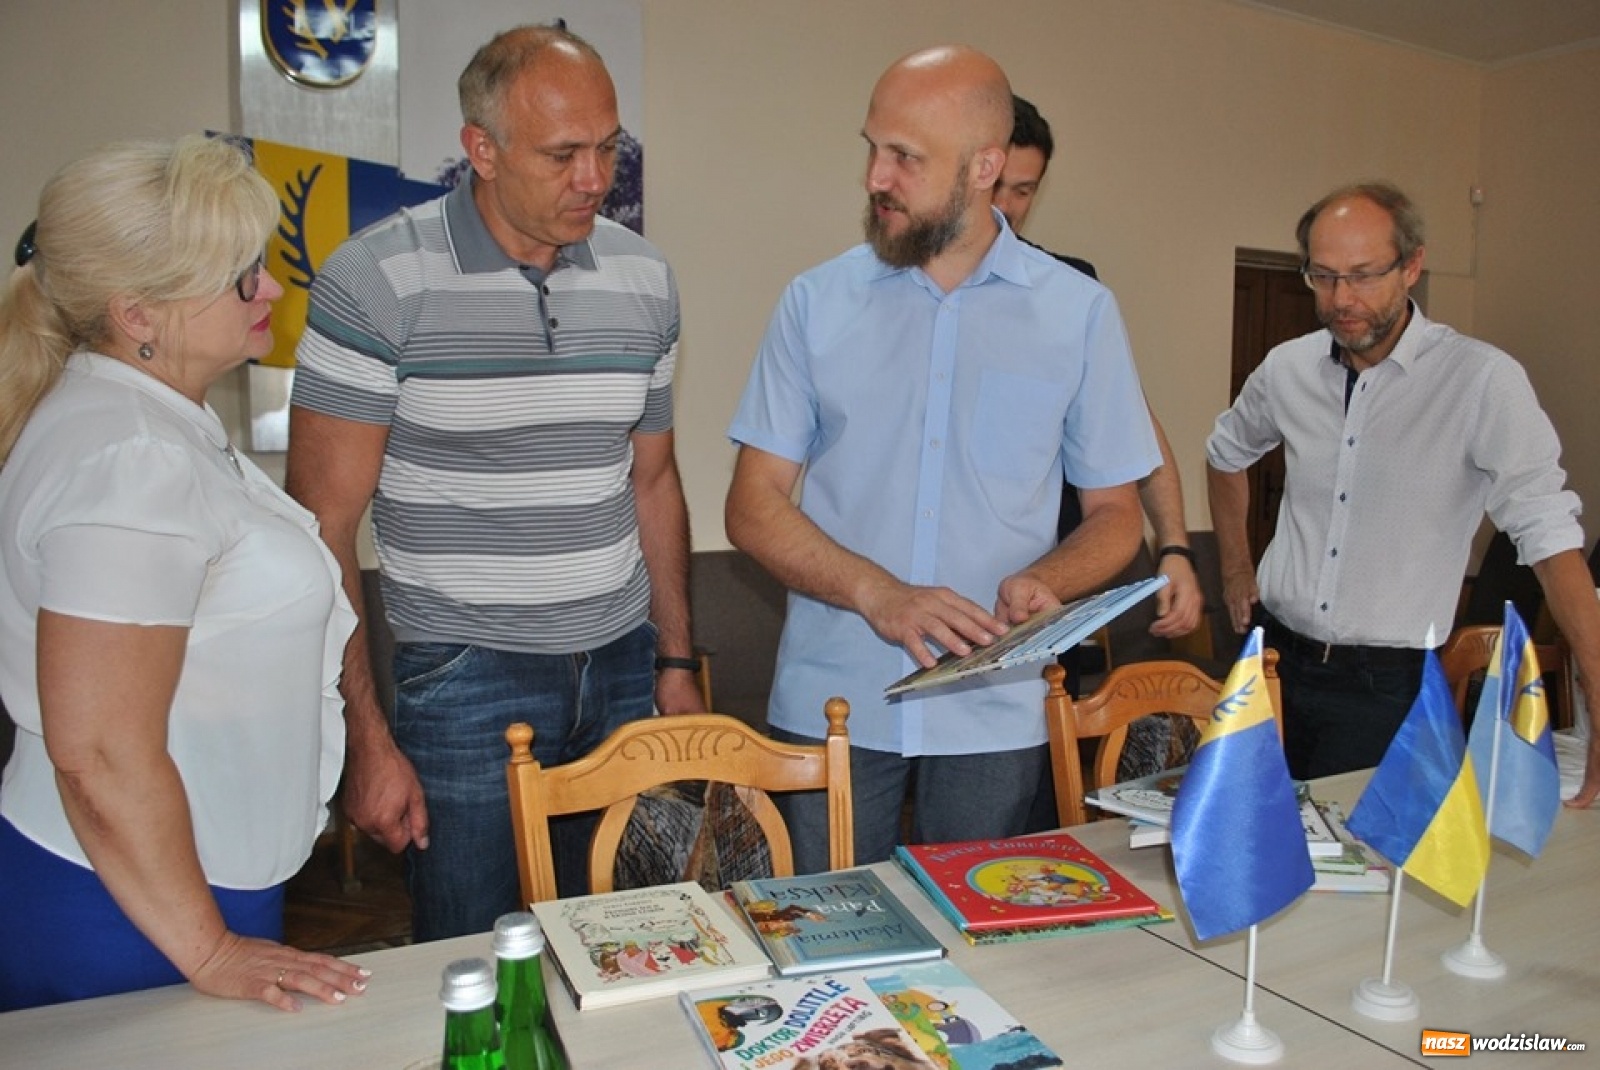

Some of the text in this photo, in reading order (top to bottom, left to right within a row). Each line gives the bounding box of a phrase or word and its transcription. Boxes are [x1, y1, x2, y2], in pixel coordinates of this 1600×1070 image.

[815, 899, 886, 914] Pana
[798, 923, 903, 945] Akademia
[735, 1026, 801, 1060] DOKTOR
